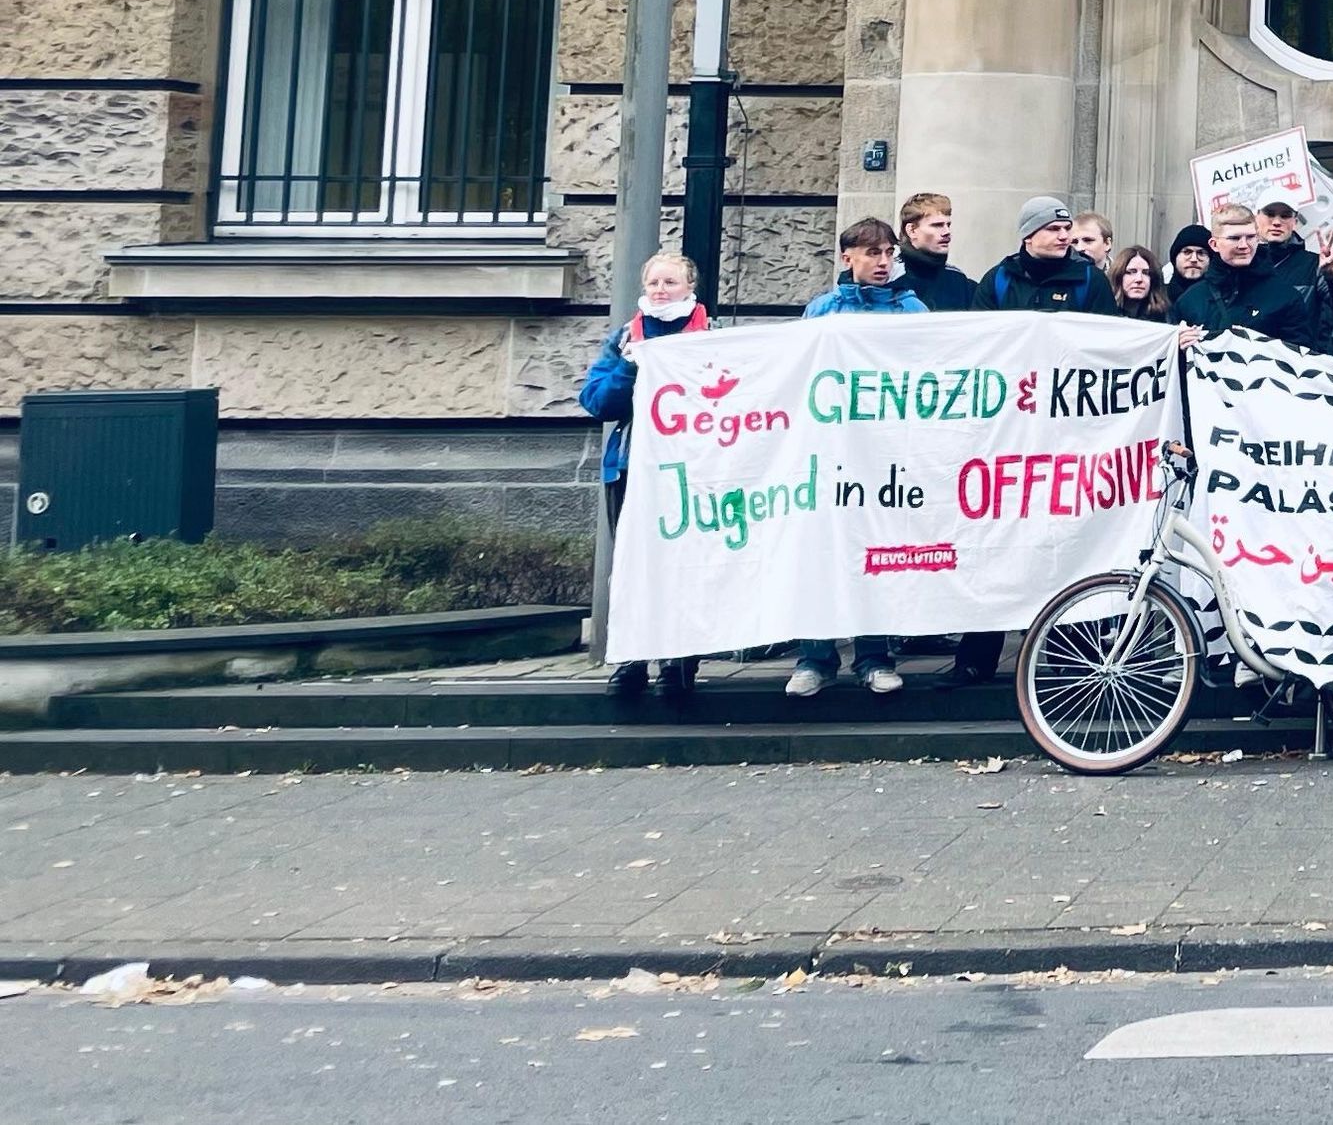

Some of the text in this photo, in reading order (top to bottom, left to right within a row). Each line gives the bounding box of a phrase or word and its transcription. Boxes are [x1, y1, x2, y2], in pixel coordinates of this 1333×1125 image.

[1211, 146, 1292, 185] Achtung!
[650, 383, 790, 447] Gegen
[808, 369, 1007, 424] GENOZID
[1050, 358, 1167, 418] KRIEGE
[658, 438, 1163, 551] Jugend in die OFFENSIVE
[871, 550, 953, 566] REVOLUTION
